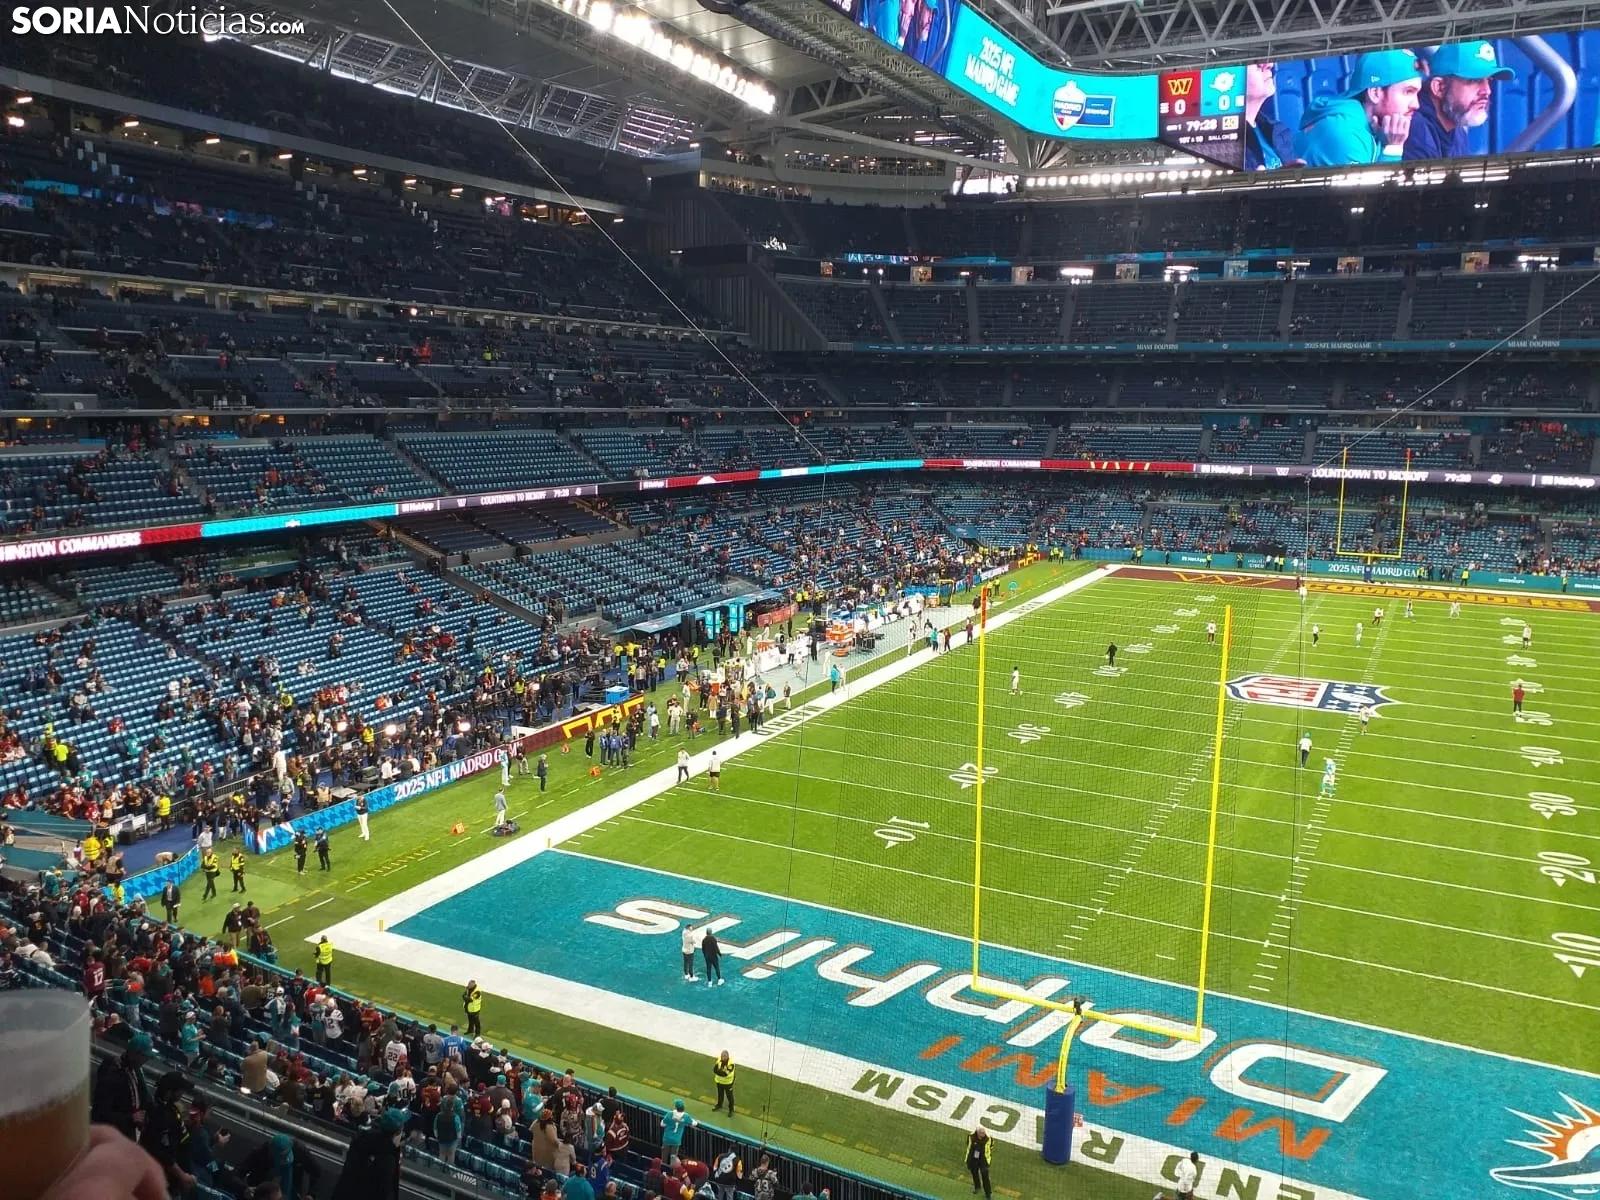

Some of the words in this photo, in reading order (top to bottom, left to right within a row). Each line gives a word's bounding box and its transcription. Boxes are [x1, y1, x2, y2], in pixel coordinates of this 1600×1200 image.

[1175, 99, 1186, 114] 0
[1219, 95, 1230, 110] 0
[1372, 470, 1386, 480] TO
[58, 532, 141, 554] COMMANDERS
[1328, 564, 1350, 573] 2025
[1305, 583, 1592, 612] COMMANDERS
[394, 775, 426, 800] 2025
[426, 768, 449, 790] NFL
[449, 752, 493, 779] MADRID
[1528, 791, 1578, 816] 30
[873, 815, 931, 842] 10
[1537, 851, 1596, 884] 20
[919, 1036, 1332, 1160] MIAMI
[850, 1068, 1125, 1166] RCISM
